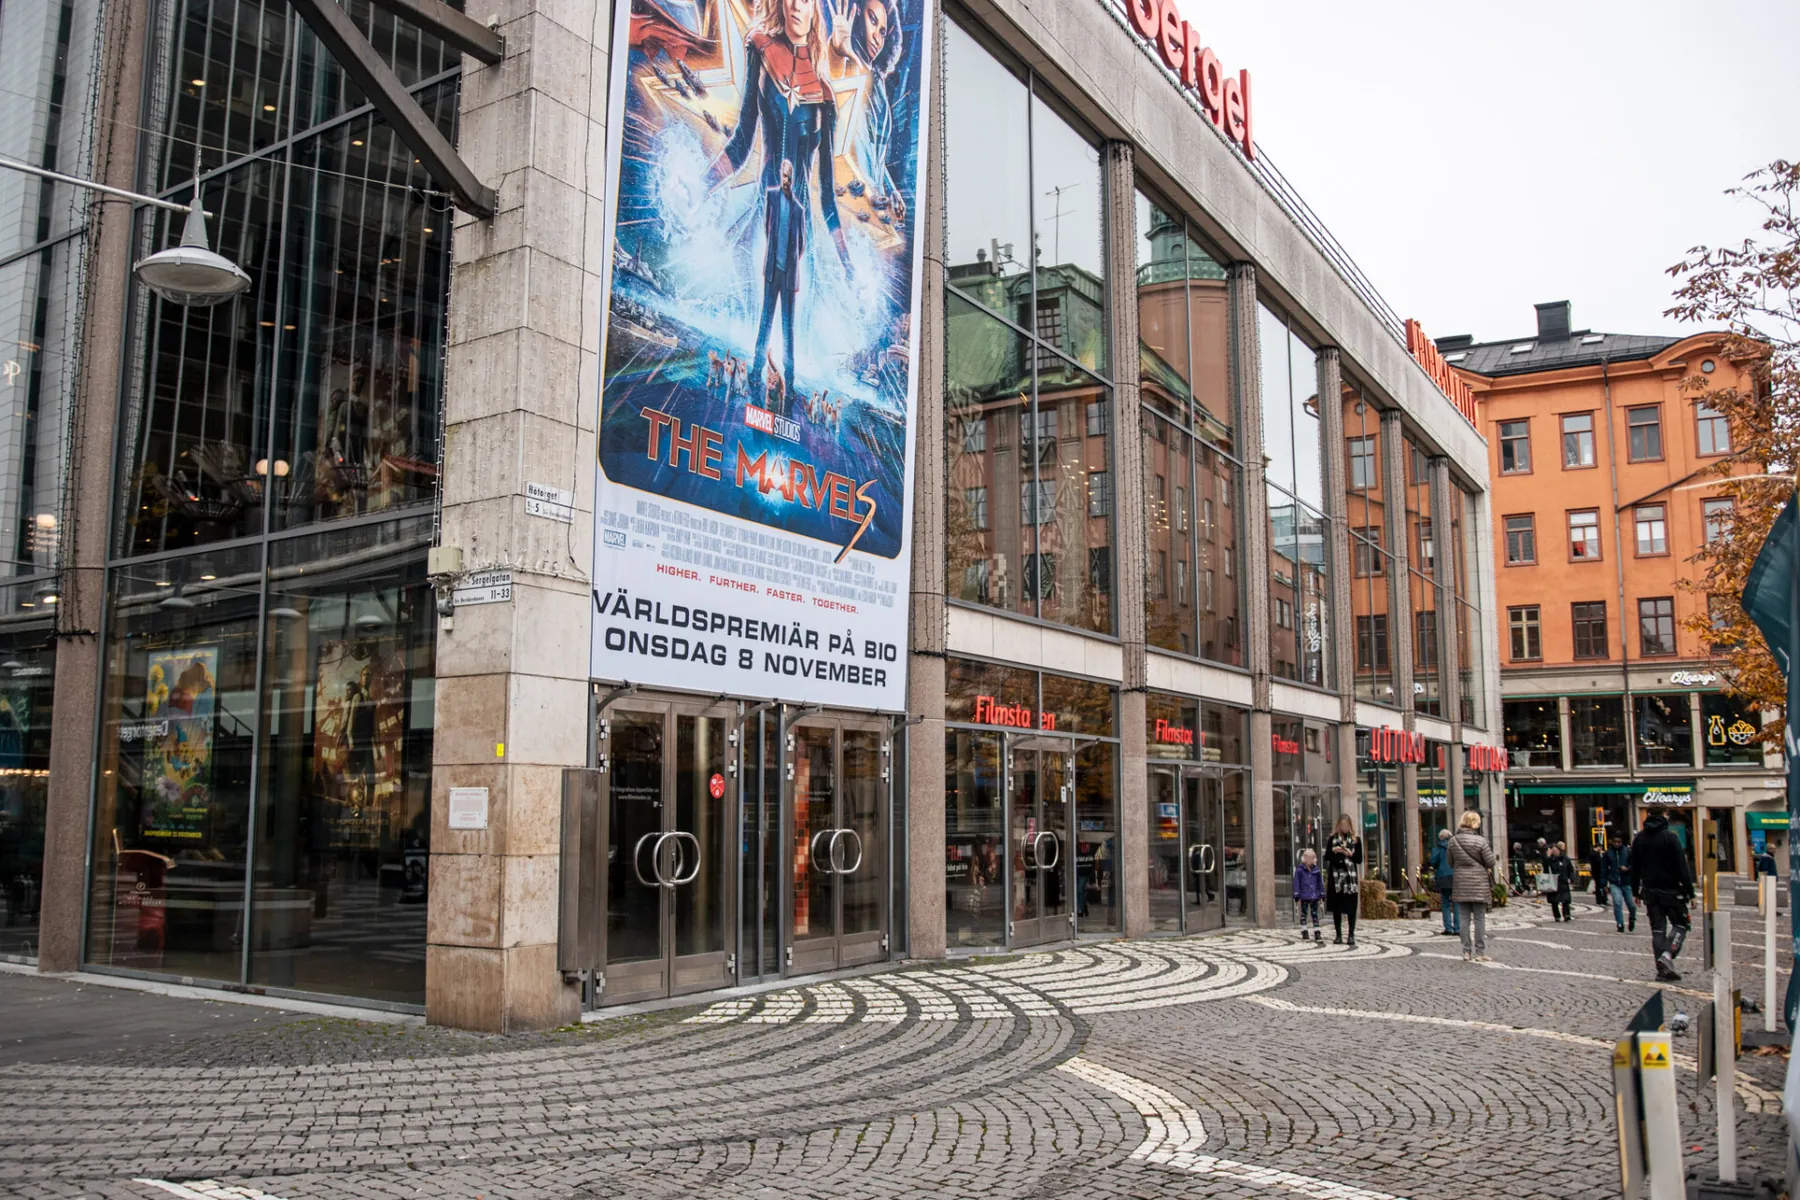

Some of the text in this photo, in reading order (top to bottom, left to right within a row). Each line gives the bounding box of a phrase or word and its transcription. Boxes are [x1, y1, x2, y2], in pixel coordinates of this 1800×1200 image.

[746, 406, 800, 442] MARVEL STUDIOS
[640, 406, 723, 480] THE
[735, 440, 877, 564] MARVELS
[471, 573, 510, 586] Sergelgatan
[490, 588, 510, 600] 11-33
[656, 564, 859, 615] HIGHER. FURTHER. FASTER. TOGETHER.
[592, 588, 897, 662] VÄRLDSPREMIÄR PÅ BIO
[605, 627, 887, 688] ONSDAG 8 NOVEMBER
[976, 695, 1055, 731] Filmstaen
